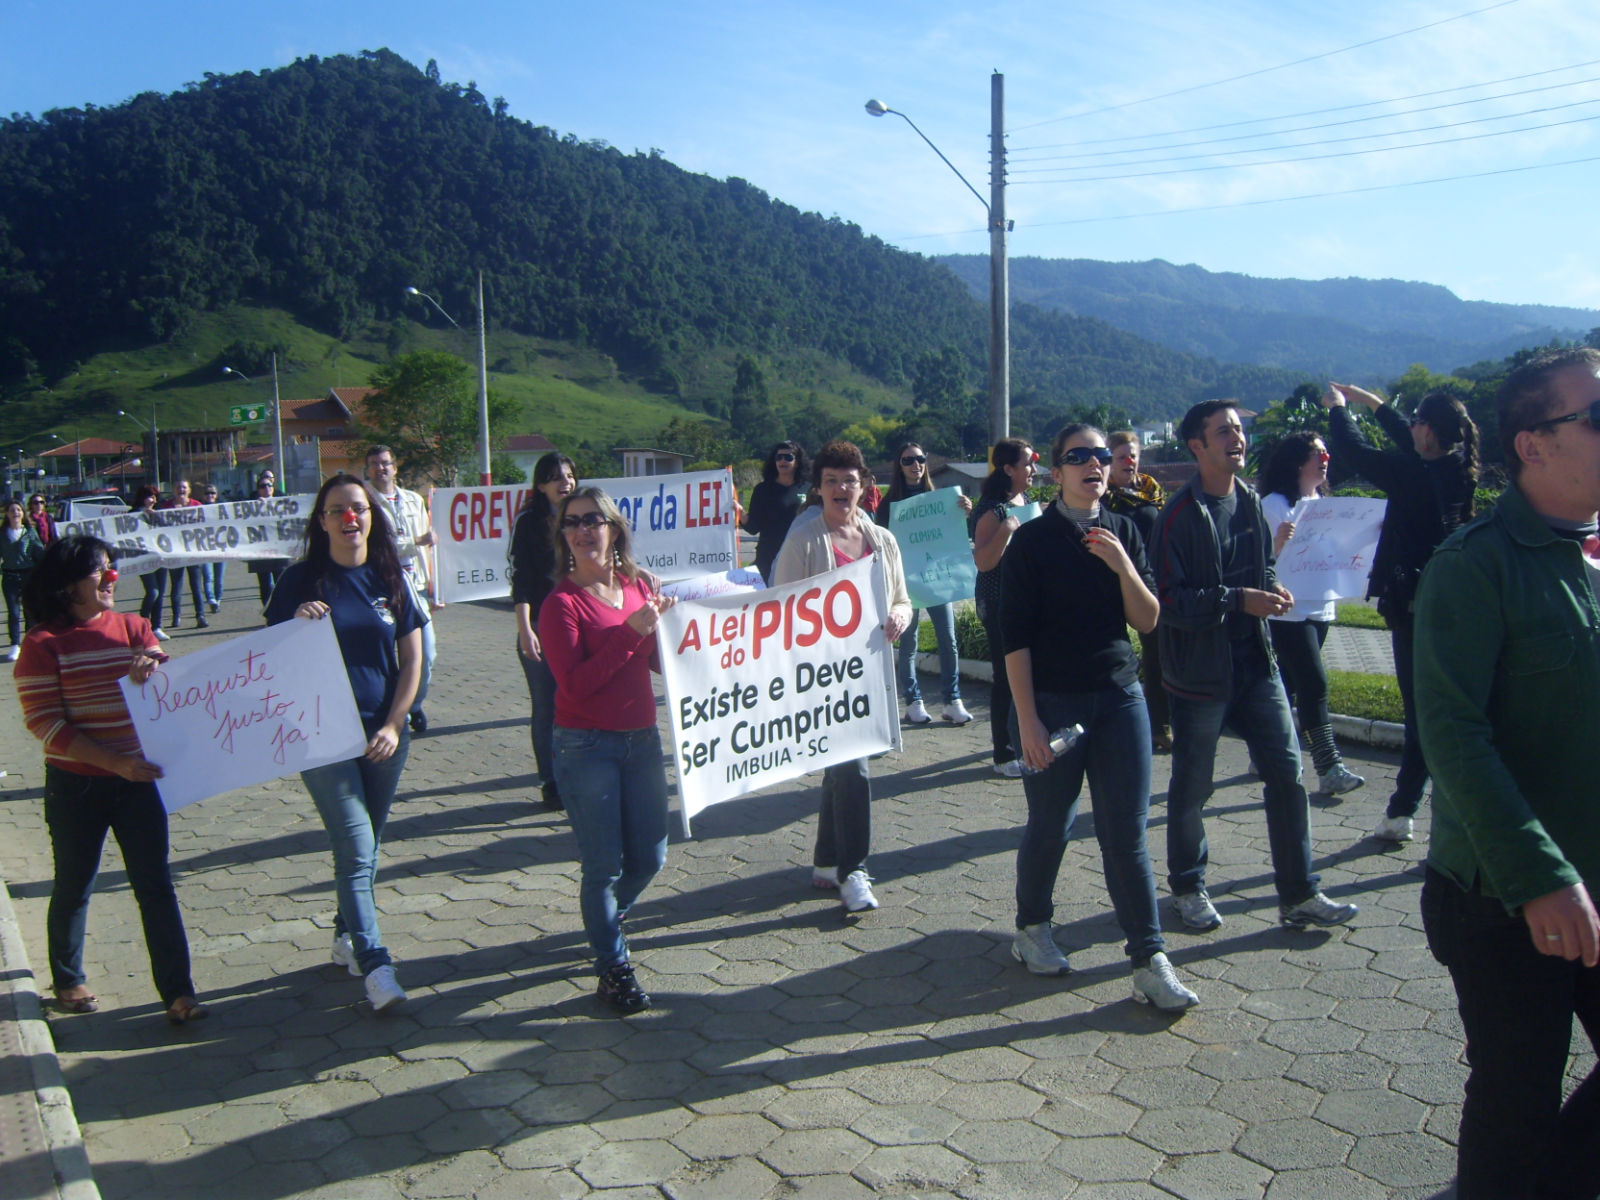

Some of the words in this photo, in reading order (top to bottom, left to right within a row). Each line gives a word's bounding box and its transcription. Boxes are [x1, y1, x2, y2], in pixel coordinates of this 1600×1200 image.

[218, 504, 230, 520] A
[649, 483, 677, 531] da
[685, 481, 729, 528] LEI.
[157, 533, 173, 553] O
[181, 525, 239, 552] PREÇO
[926, 551, 933, 561] A
[457, 568, 499, 585] E.E.B.
[646, 553, 677, 568] Vidal
[689, 551, 733, 566] Ramos
[677, 618, 701, 655] A
[708, 604, 749, 648] Lei
[720, 644, 745, 670] do
[752, 579, 863, 661] PISO
[141, 650, 274, 721] Reajuste
[680, 682, 758, 731] Existe
[768, 676, 784, 701] e
[796, 655, 864, 694] Deve
[681, 735, 720, 776] Ser
[731, 690, 870, 754] Cumprida
[726, 747, 792, 783] IMBUIA
[808, 736, 829, 757] SC
